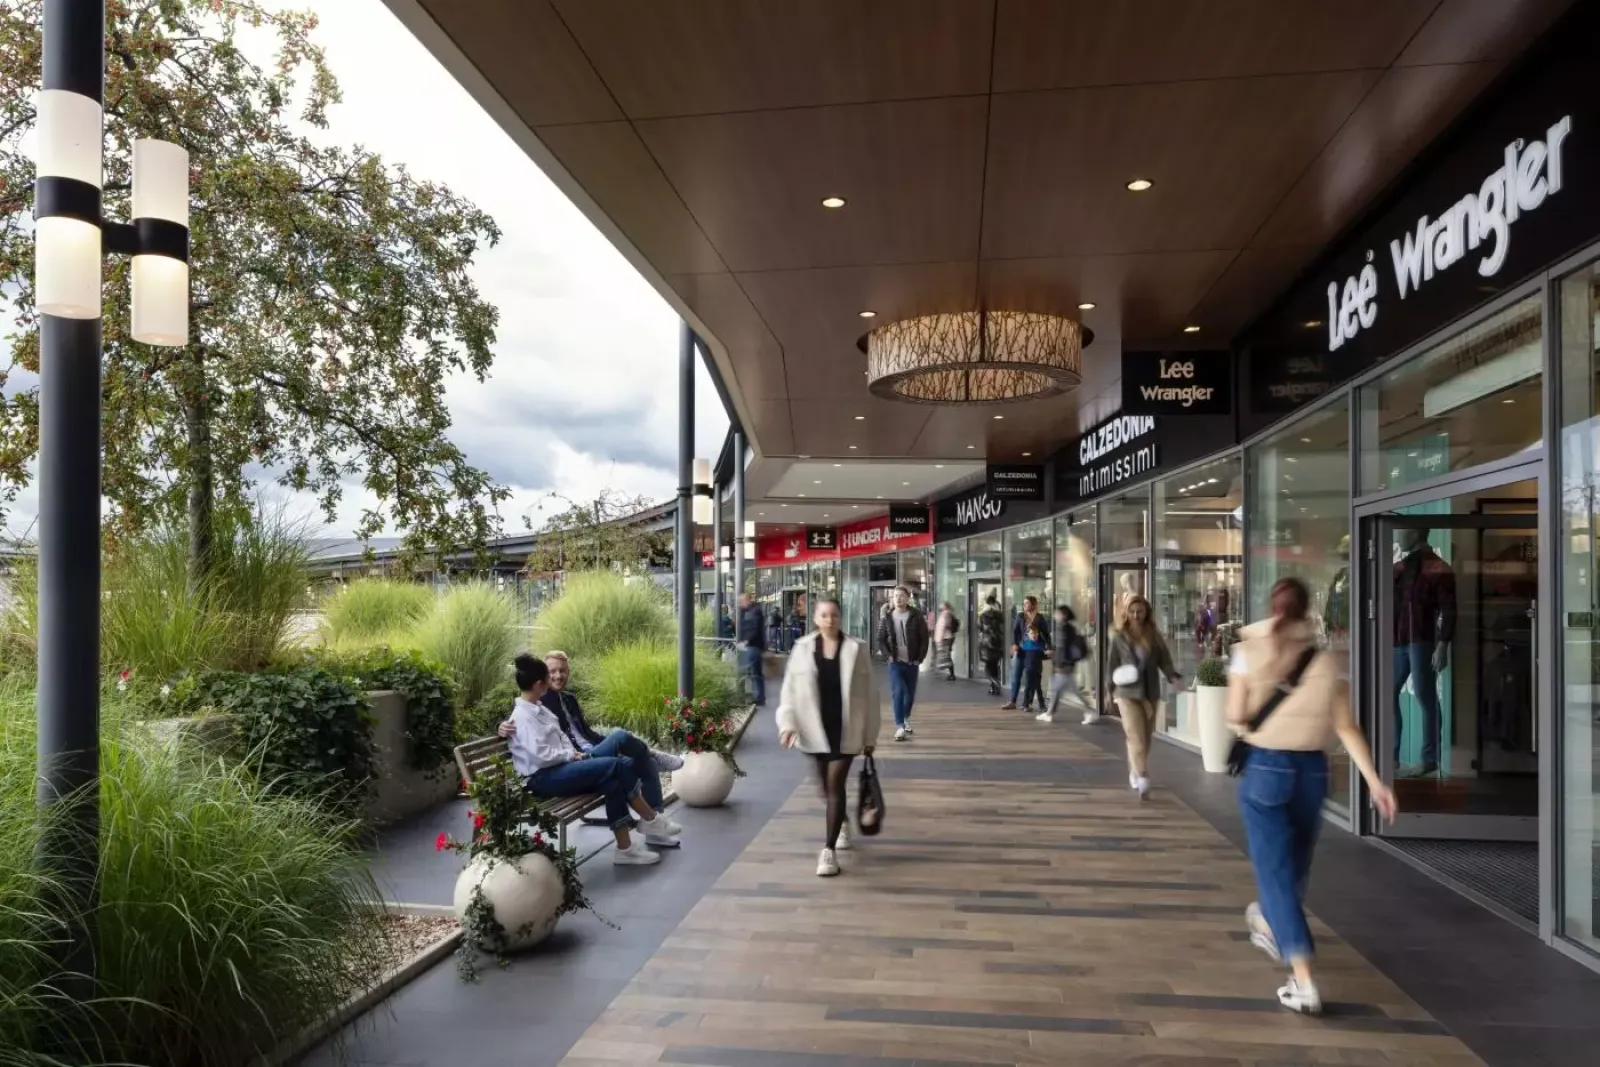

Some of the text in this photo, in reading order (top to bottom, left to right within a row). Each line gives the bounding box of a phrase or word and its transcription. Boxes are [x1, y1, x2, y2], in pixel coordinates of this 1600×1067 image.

[1328, 115, 1570, 351] Lee Wrangler
[1159, 359, 1194, 378] Lee
[1140, 385, 1214, 407] Wrangler
[852, 528, 881, 546] UNDER
